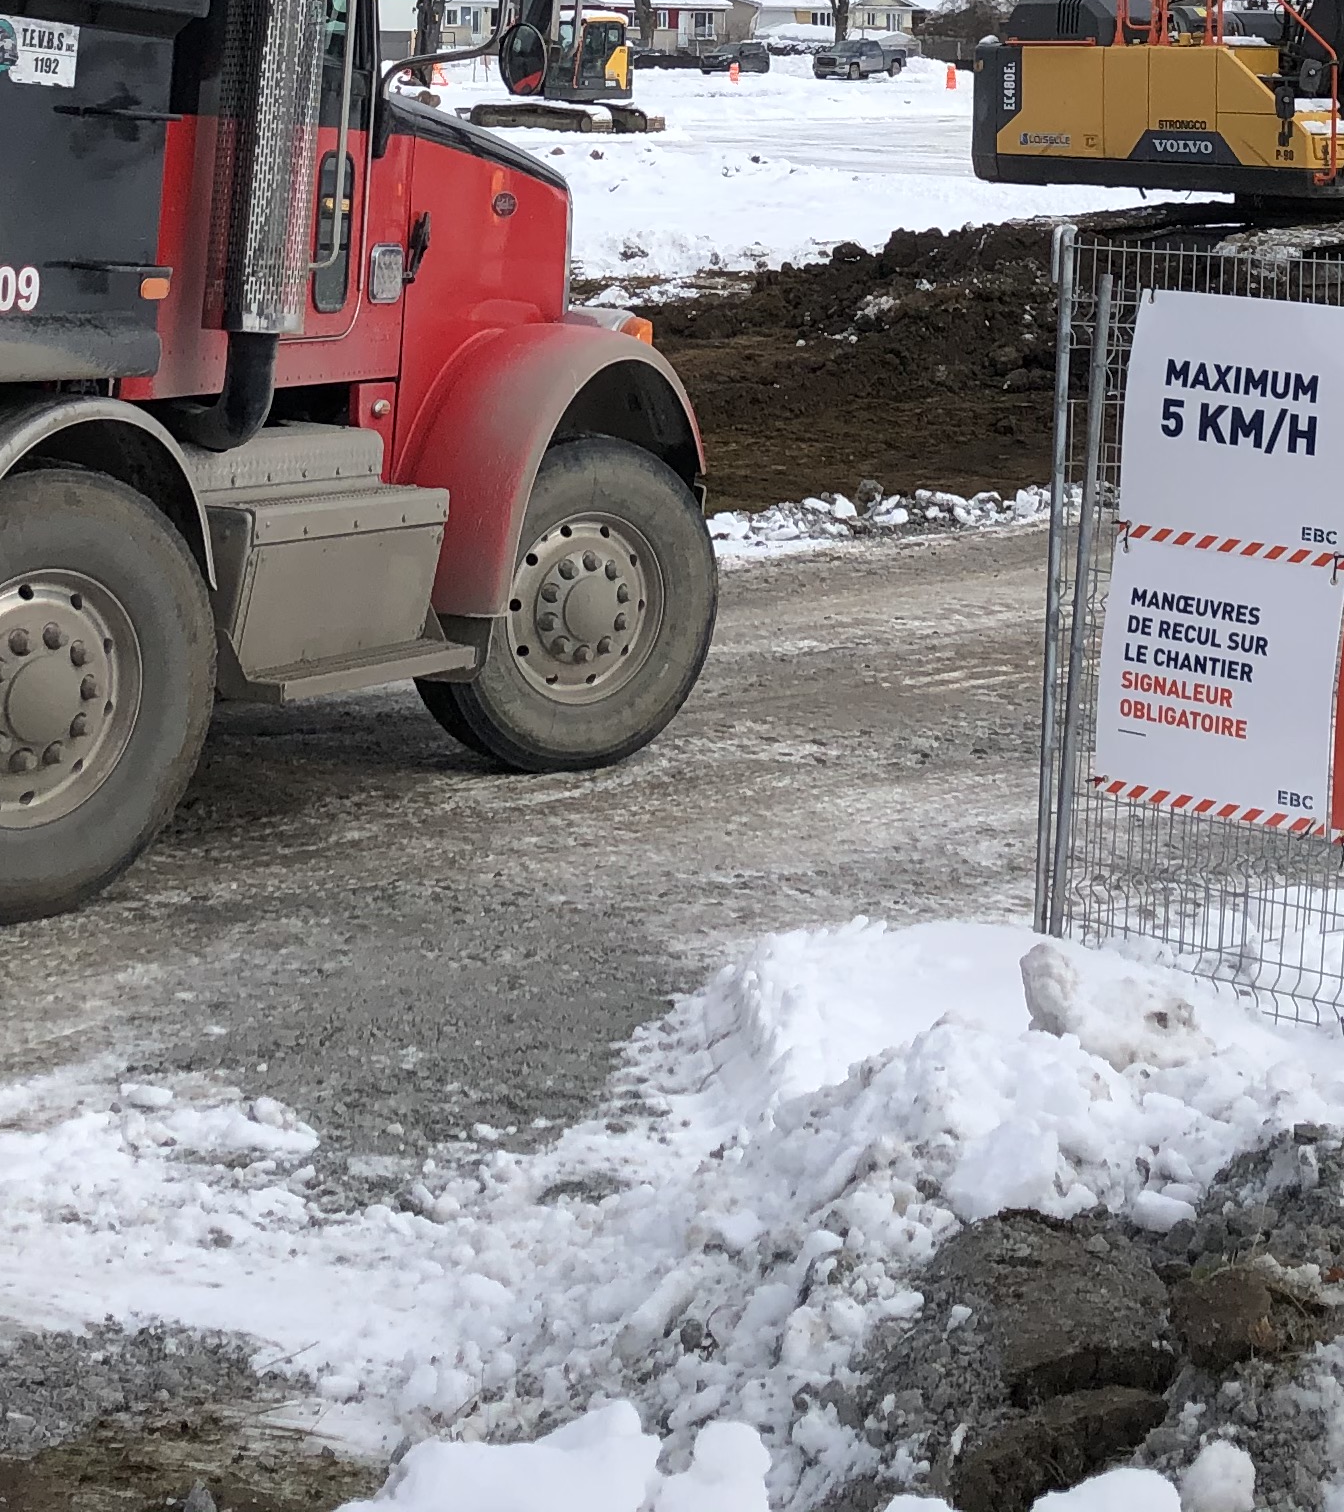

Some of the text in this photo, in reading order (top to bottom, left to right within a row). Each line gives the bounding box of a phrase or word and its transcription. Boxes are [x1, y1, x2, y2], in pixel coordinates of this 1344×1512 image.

[34, 56, 60, 74] 1192
[1158, 119, 1207, 130] STRONGCO
[1152, 138, 1213, 154] VOLVO
[1165, 358, 1319, 403] MAXIMUM
[1160, 398, 1318, 456] 5 KM/H
[1301, 526, 1338, 545] EBC
[1130, 587, 1261, 625] MANŒUVRES
[1127, 614, 1269, 656] DE RECUL SUR
[1124, 642, 1254, 683] LE CHANTIER
[1120, 670, 1233, 709] SIGNALEUR
[1119, 698, 1248, 739] OBLIGATOIRE
[1277, 789, 1314, 810] EBC
